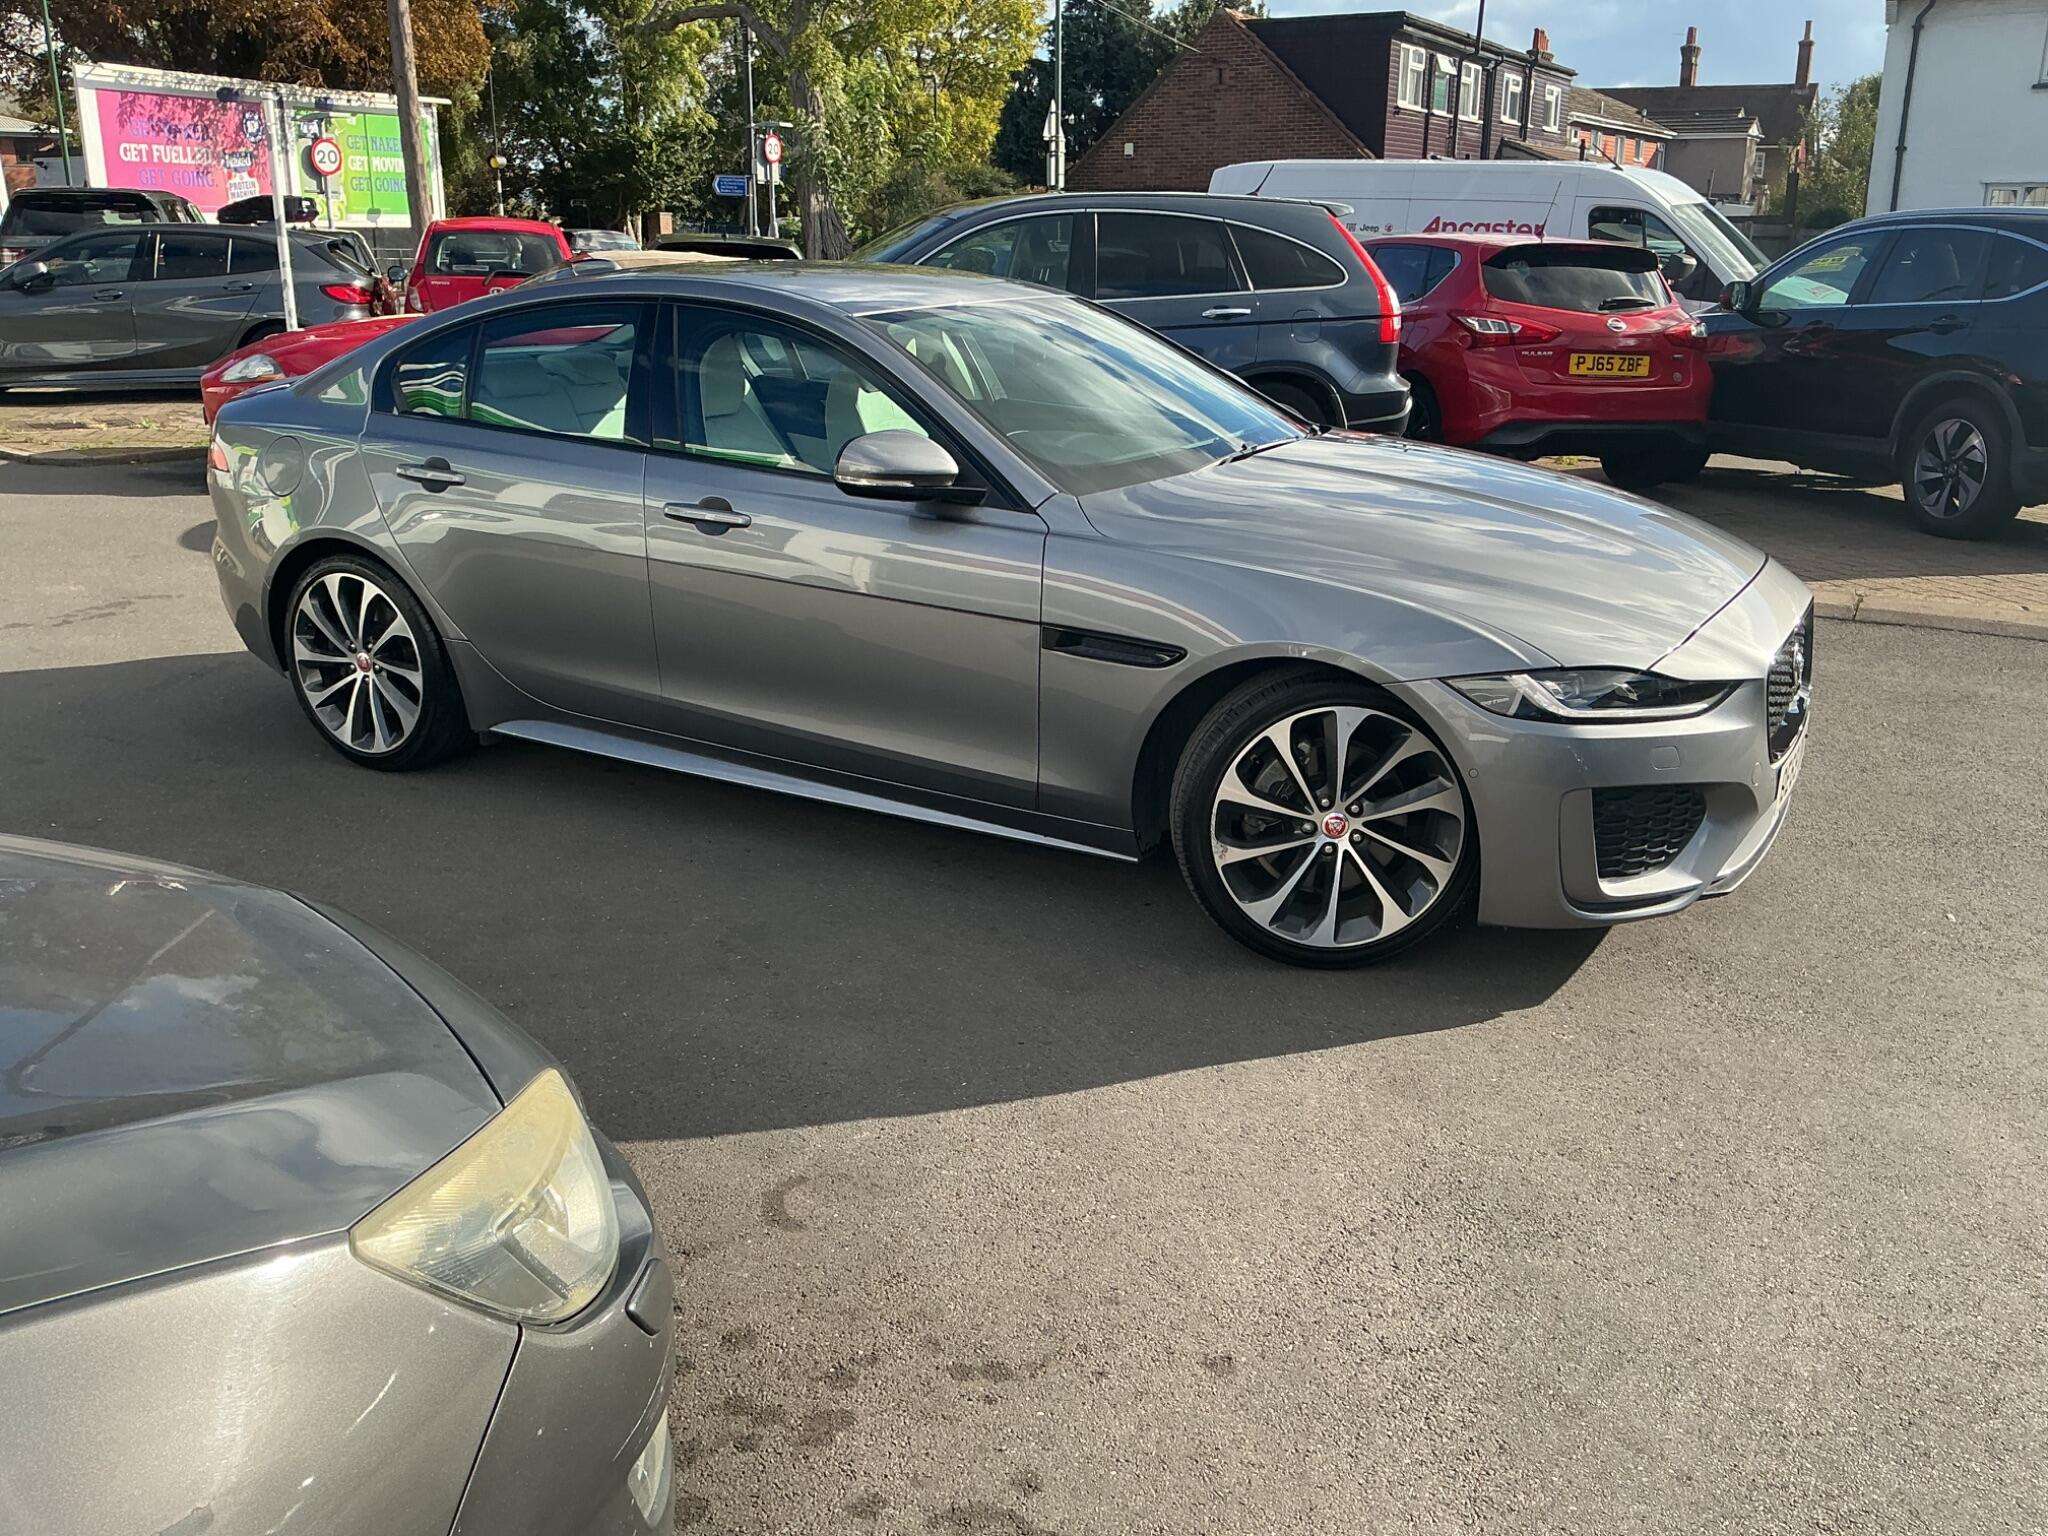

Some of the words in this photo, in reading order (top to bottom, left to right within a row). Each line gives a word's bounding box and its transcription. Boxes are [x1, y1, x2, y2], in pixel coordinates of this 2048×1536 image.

[347, 135, 367, 151] GET
[370, 135, 400, 152] NAKE
[768, 143, 778, 155] 20
[119, 143, 148, 163] GET
[316, 149, 337, 164] 20
[349, 156, 369, 172] GET
[138, 168, 164, 185] GET
[229, 180, 256, 191] PROTEIN
[351, 177, 371, 192] GET
[230, 189, 257, 200] MACHINE
[1359, 223, 1380, 233] Jeep
[1422, 215, 1545, 236] Ancaster
[1574, 356, 1615, 372] PJ65
[1616, 357, 1644, 373] ZBF
